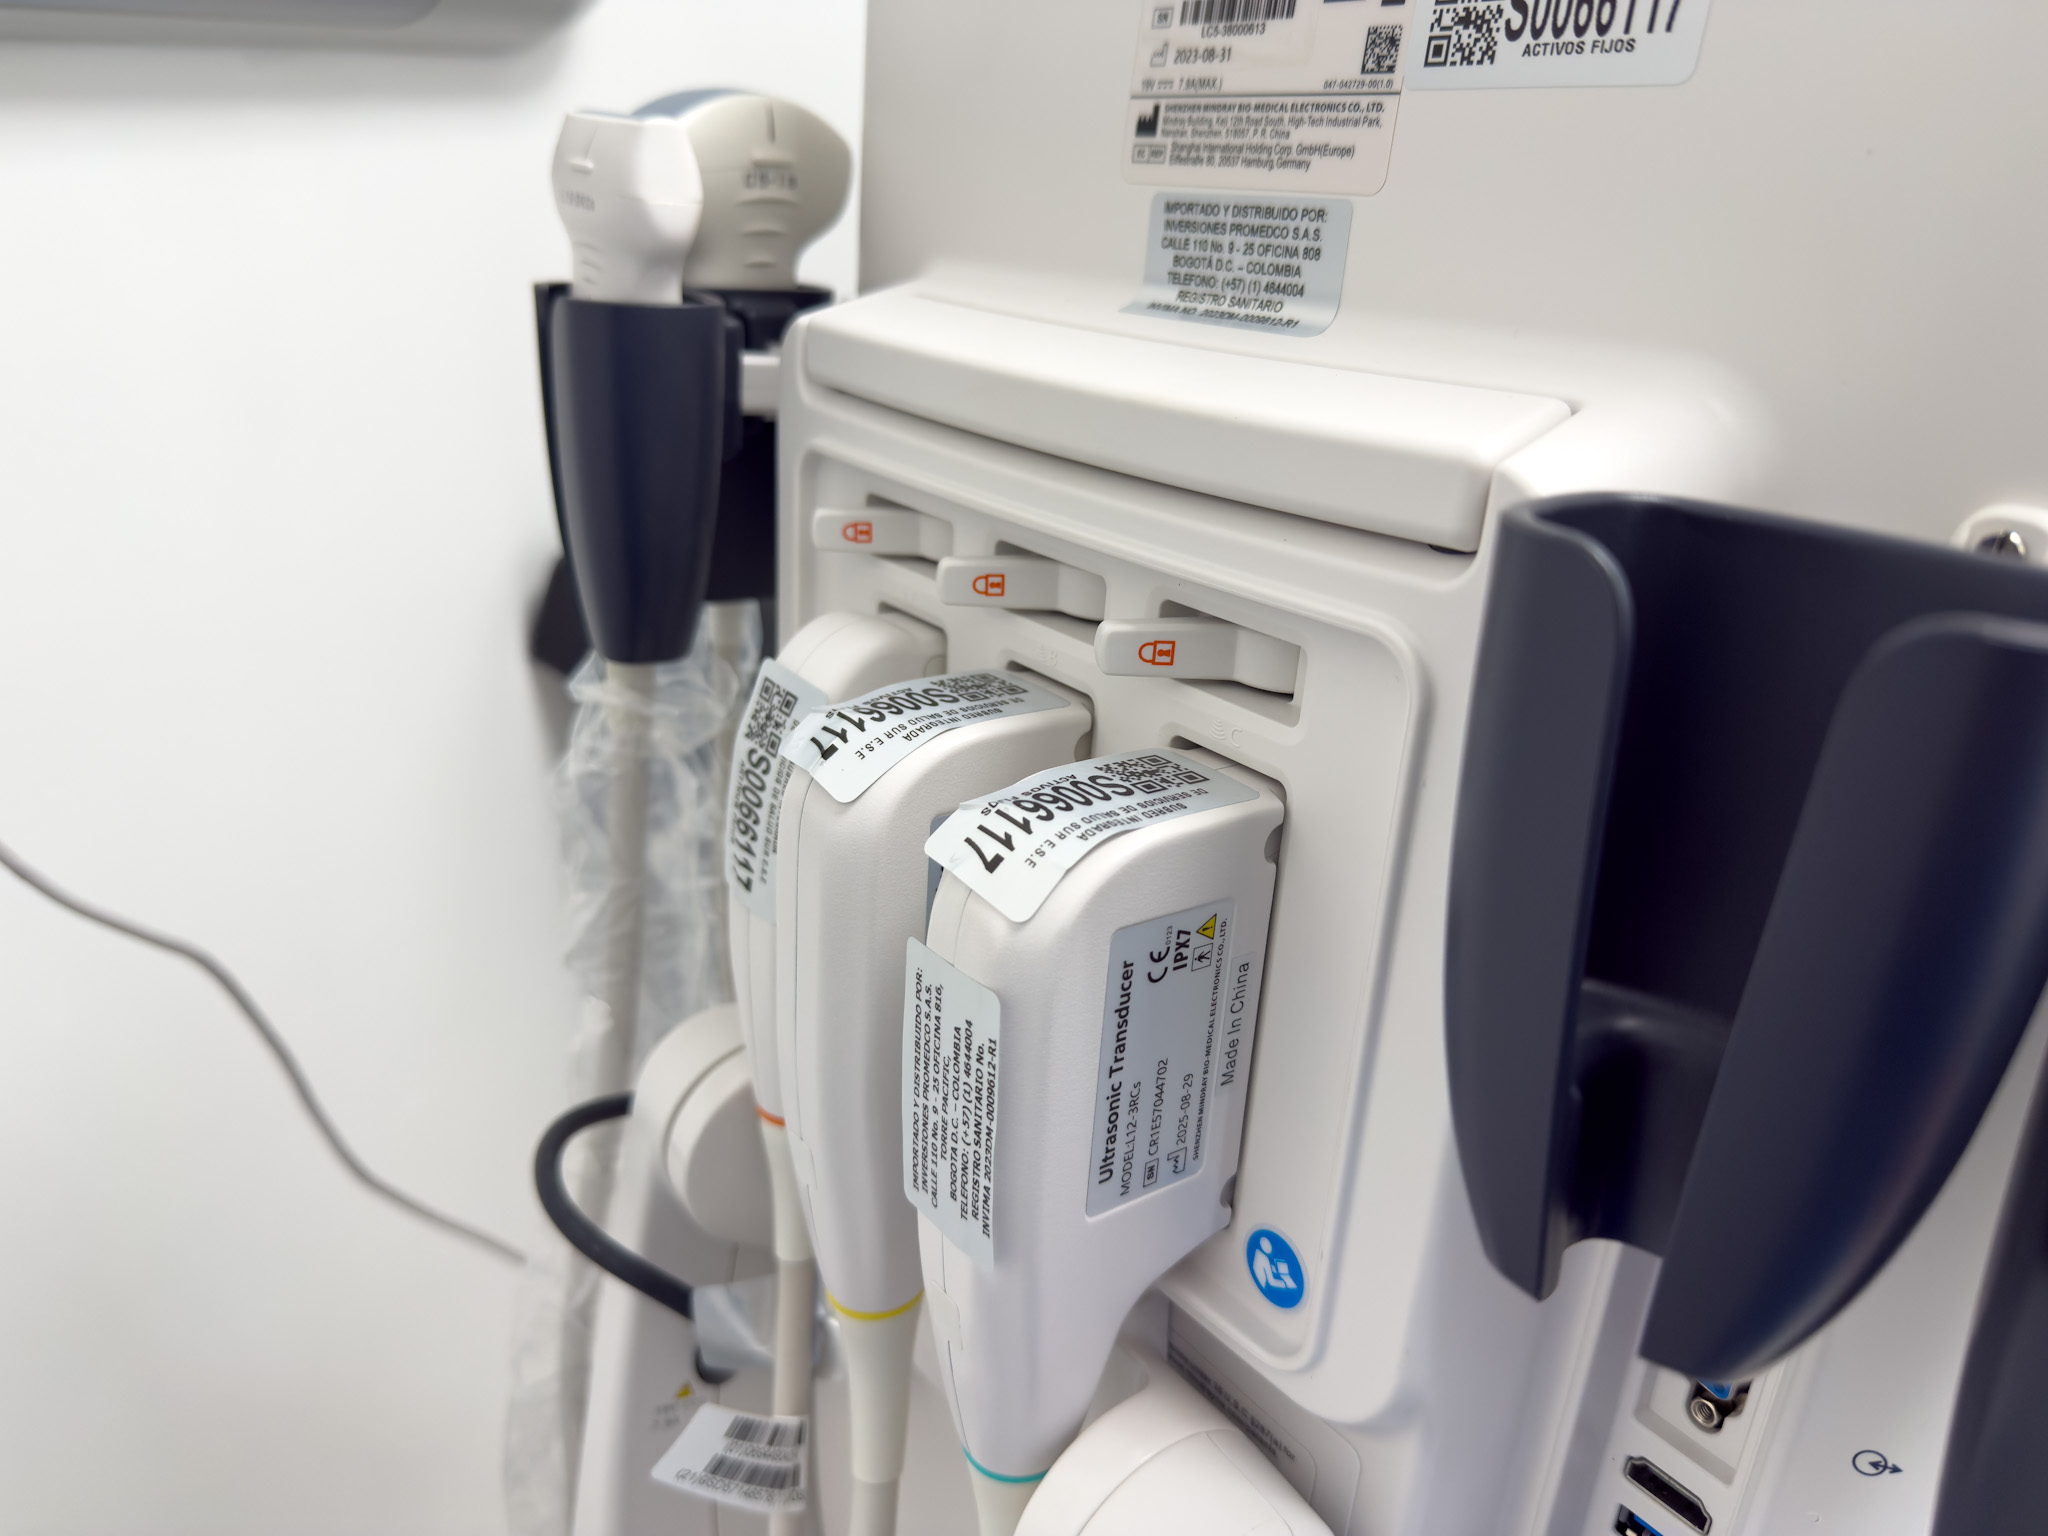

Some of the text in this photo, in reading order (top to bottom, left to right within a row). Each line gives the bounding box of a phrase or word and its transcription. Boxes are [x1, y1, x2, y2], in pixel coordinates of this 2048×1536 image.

[1173, 47, 1232, 65] 2023-08-31
[1522, 38, 1636, 57] ACTIVOS FIJOS
[1203, 103, 1236, 113] MINDRAY
[1237, 102, 1289, 113] BIO-MEDICAL
[1290, 102, 1346, 113] ELECTRONICS
[1366, 102, 1385, 113] LTD.
[1245, 116, 1263, 127] Road
[1287, 116, 1324, 130] High-Tech
[1325, 116, 1360, 128] Industrial
[1361, 116, 1382, 129] Park,
[1269, 129, 1291, 140] China
[1202, 143, 1243, 154] International
[1244, 144, 1273, 157] Holding
[1273, 144, 1293, 158] Corp.
[1295, 144, 1355, 159] GmbH(Europe)
[1276, 158, 1311, 173] Germany
[1164, 200, 1328, 223] IMPORTADO Y DISTRIBUIDO POR:
[1163, 218, 1322, 242] INVERSIONES PROMEDCO S.A.S.
[1161, 236, 1190, 251] CALLE
[1193, 238, 1208, 252] 110
[1210, 240, 1225, 253] No.
[1228, 241, 1235, 255] 9
[1242, 242, 1254, 256] 25
[1256, 243, 1300, 260] OFICINA
[1302, 247, 1321, 261] 808
[1173, 254, 1213, 271] BOGOTÁ
[1215, 259, 1235, 273] D.C.
[1246, 261, 1301, 278] COLOMBIA
[1167, 271, 1218, 289] TELEFONO:
[1221, 276, 1246, 295] (+57)
[1247, 280, 1260, 296] (1)
[1176, 289, 1284, 314] REGISTRO SANITARIO
[810, 687, 961, 761] S0066117
[901, 707, 1003, 743] SUBRED INTEGRADA
[907, 711, 942, 727] SALUD
[941, 708, 959, 717] DE
[884, 722, 908, 740] SUR
[854, 736, 885, 761] E.S.E
[1021, 772, 1078, 800] ACTIVOS
[1117, 803, 1137, 815] DE
[1136, 789, 1195, 810] SERVICIOS
[732, 747, 772, 893] S0066117
[964, 773, 1136, 875] S0066117
[1076, 802, 1188, 842] SUBRED INTEGRADA
[1082, 809, 1121, 828] SALUD
[1055, 822, 1082, 843] SUR
[1024, 840, 1057, 870] E.S.E
[1165, 925, 1174, 946] 0123
[1172, 929, 1191, 972] IPX7
[915, 967, 923, 1002] POR:
[934, 984, 944, 1013] 816,
[1220, 961, 1250, 1087] Made In China
[933, 1014, 942, 1075] OFICINA
[1193, 917, 1227, 1161] SHENZHEN MINDRAY BIO-MEDICAL ELECTRONICS CO., LTD.
[922, 1023, 931, 1102] PROMEDCO
[951, 1026, 961, 1101] COLOMBIA
[1098, 960, 1135, 1185] Ultrasonic Transducer
[932, 1076, 940, 1095] 25
[913, 1098, 920, 1109] Y
[932, 1105, 939, 1116] 9
[940, 1055, 952, 1162] TORRE PACIFIC,
[1148, 1057, 1168, 1156] CR1E57044702
[1176, 1073, 1194, 1146] 2025-08-29
[931, 1119, 939, 1142] No.
[951, 1117, 959, 1144] D.C.
[960, 1018, 973, 1221] TELEFONO: (+57) (1) 4644004
[971, 1042, 985, 1221] REGISTRO SANITARIO No.
[921, 1103, 929, 1195] INVERSIONES
[982, 1038, 997, 1239] INVIMA 2023DM-0009612-R1
[1119, 1080, 1142, 1197] MODEL:L12-3RCs
[949, 1146, 958, 1202] BOGOTA
[1146, 1164, 1155, 1180] SN
